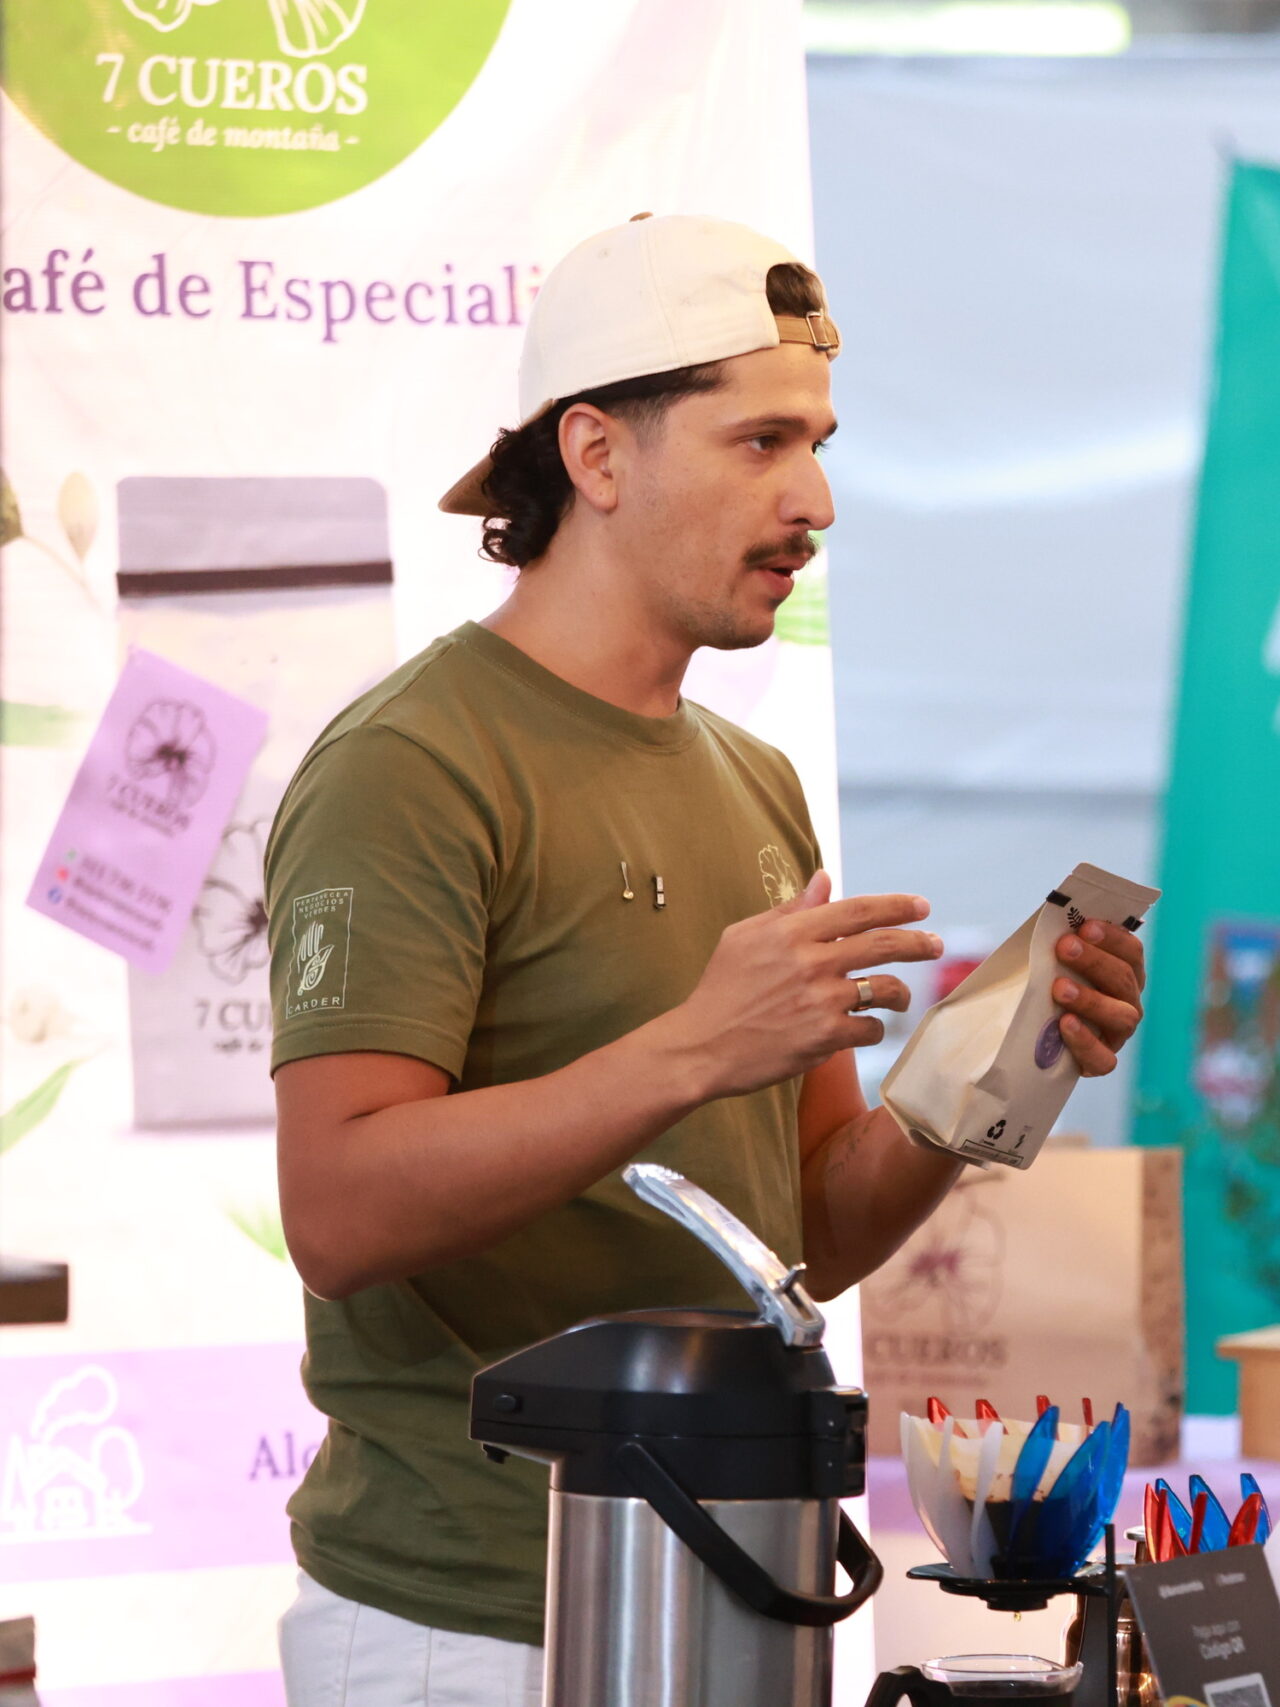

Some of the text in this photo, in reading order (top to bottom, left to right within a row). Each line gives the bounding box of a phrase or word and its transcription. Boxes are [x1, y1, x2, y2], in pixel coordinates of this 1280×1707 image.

[95, 53, 368, 116] 7 CUEROS
[127, 115, 181, 153] café
[186, 118, 217, 147] de
[222, 122, 341, 152] montaña
[2, 247, 105, 315] afé
[132, 253, 213, 317] de
[296, 891, 340, 907] PERTENECE
[299, 898, 344, 913] NEGOCIOS
[304, 905, 337, 919] VERDES
[195, 999, 272, 1033] 7 CU
[288, 996, 340, 1015] CARDER
